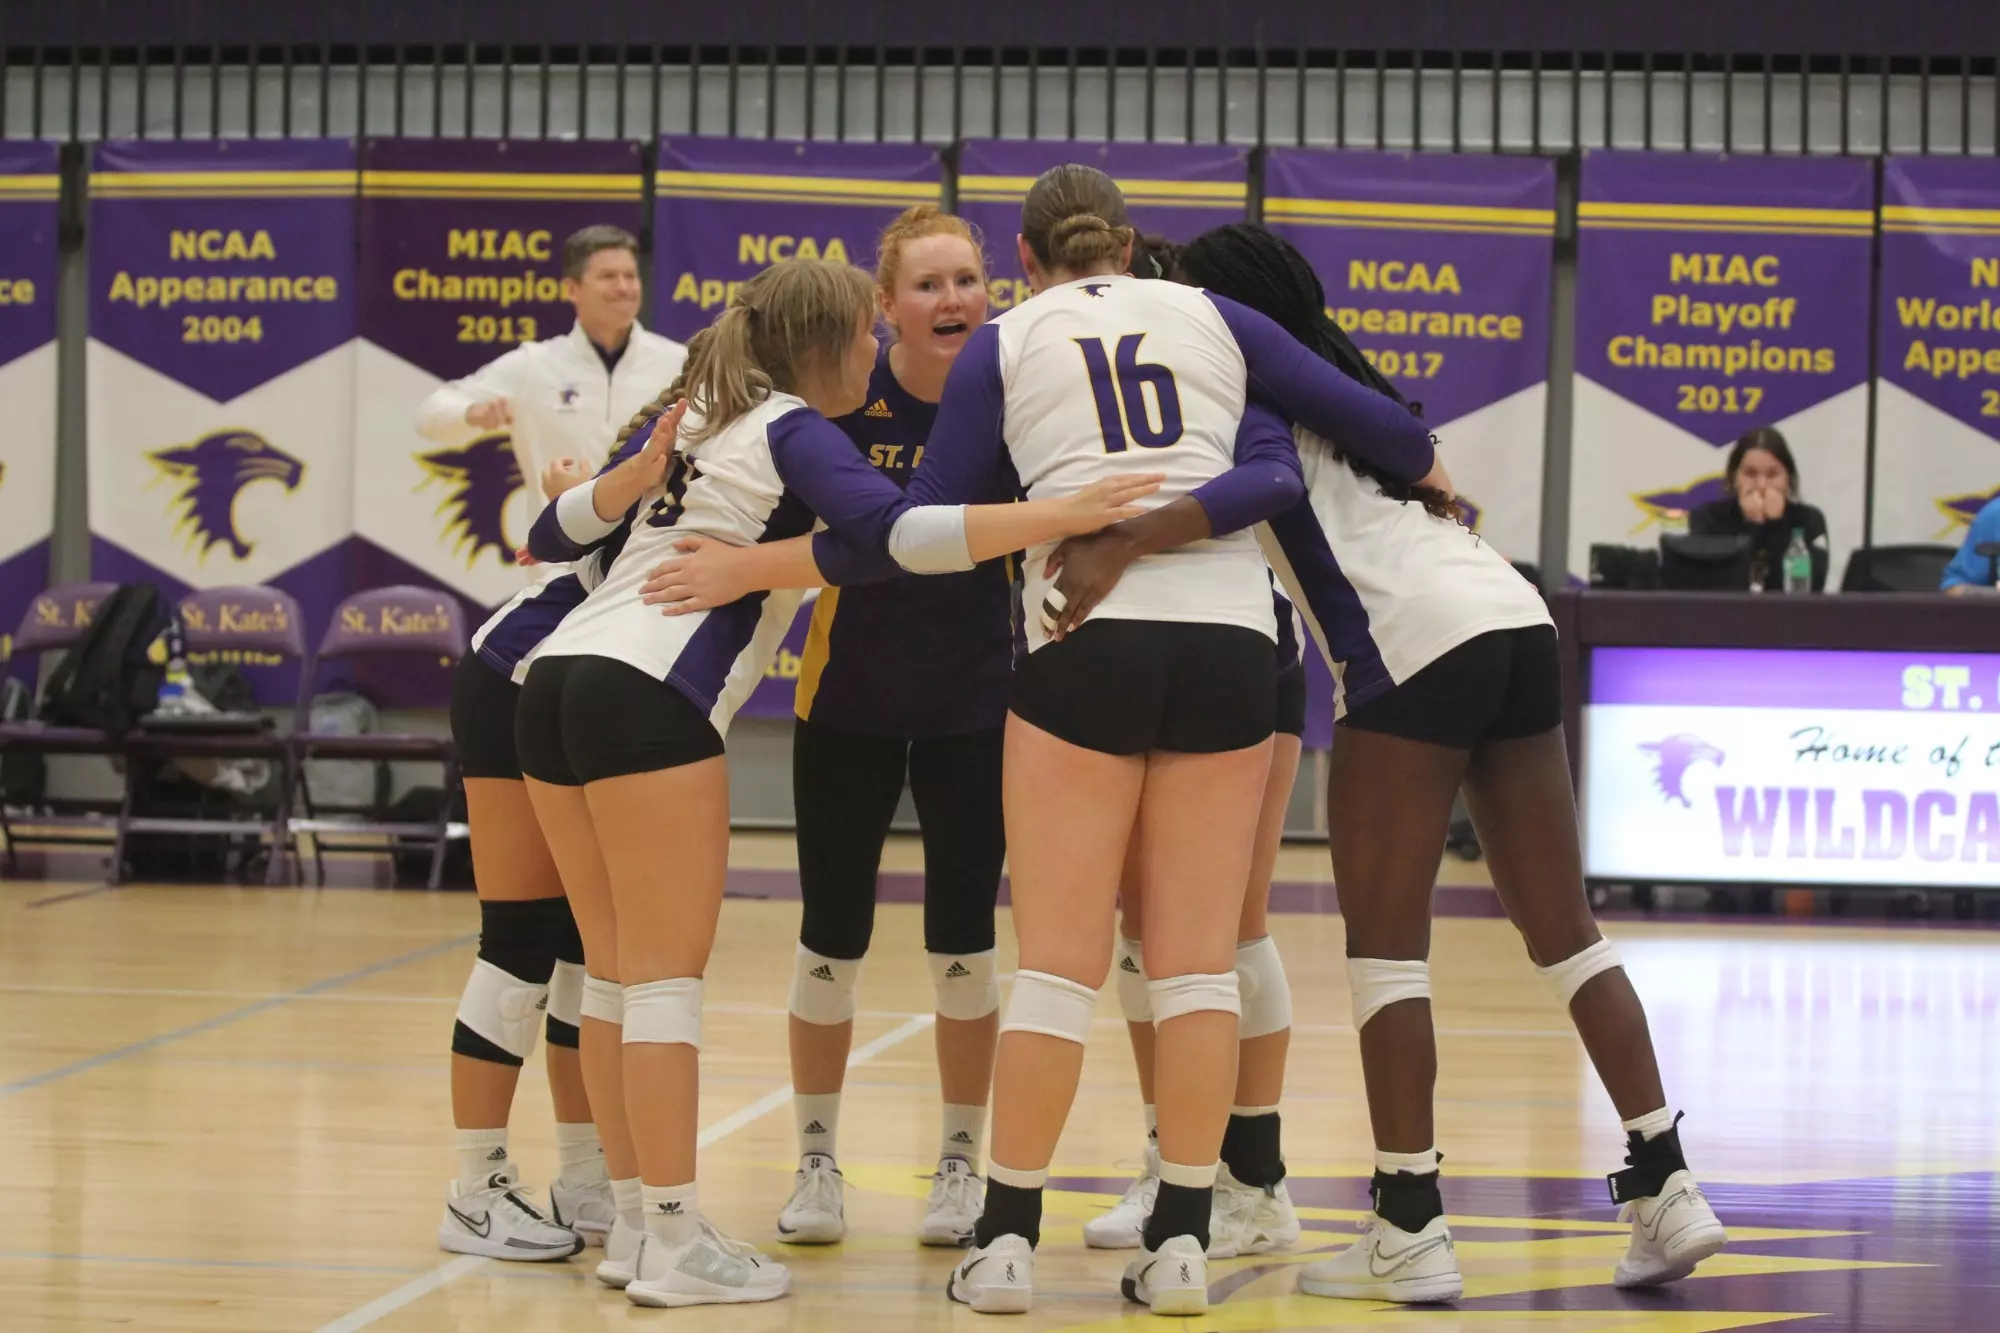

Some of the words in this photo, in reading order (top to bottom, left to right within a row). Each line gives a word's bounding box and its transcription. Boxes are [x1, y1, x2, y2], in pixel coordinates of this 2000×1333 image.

[170, 229, 276, 261] NCAA
[447, 228, 553, 261] MIAC
[738, 233, 848, 265] NCAA
[1348, 259, 1462, 294] NCAA
[1670, 253, 1780, 286] MIAC
[108, 270, 338, 309] Appearance
[182, 315, 264, 343] 2004
[456, 315, 538, 342] 2013
[1325, 305, 1524, 340] pearance
[1651, 294, 1797, 334] Playoff
[1607, 335, 1836, 376] Champions
[1069, 331, 1184, 454] 16
[1677, 385, 1764, 413] 2017
[864, 410, 893, 418] adidas
[868, 444, 904, 469] ST.
[219, 603, 288, 632] Kate's
[341, 605, 374, 634] St.
[380, 604, 450, 634] Kate's
[1902, 664, 1983, 709] ST.
[1789, 726, 1908, 764] Home
[1929, 734, 1969, 778] of
